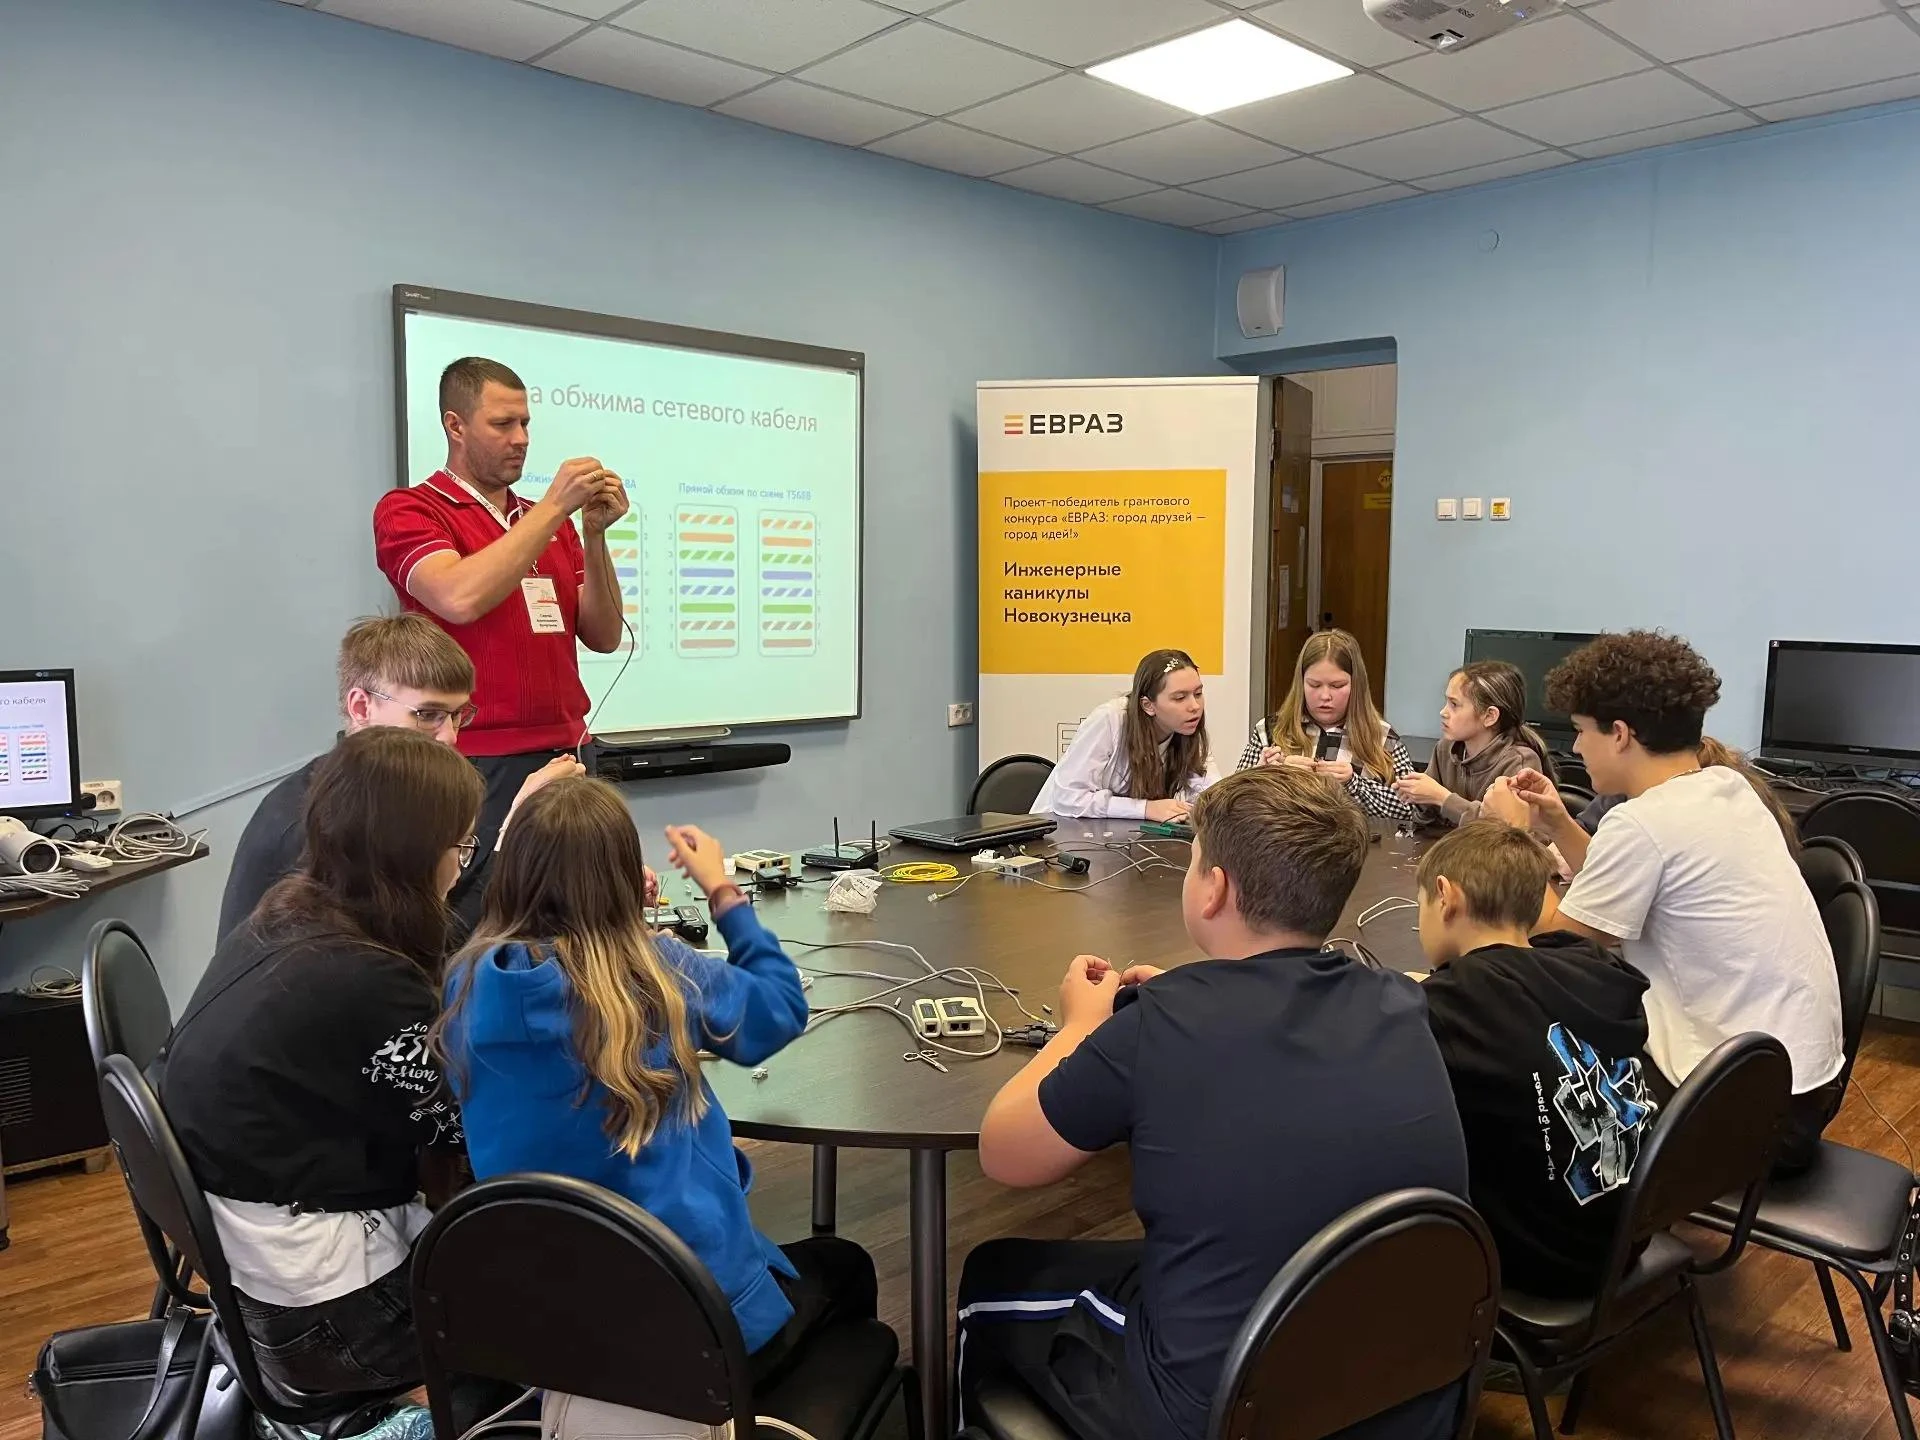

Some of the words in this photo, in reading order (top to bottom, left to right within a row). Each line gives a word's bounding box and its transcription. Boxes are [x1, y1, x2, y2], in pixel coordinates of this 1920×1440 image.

[551, 384, 645, 414] обжима
[652, 399, 745, 425] сетевого
[751, 407, 817, 432] кабеля
[1029, 413, 1123, 435] ЕВРАЗ
[679, 482, 714, 495] Прямой
[747, 489, 758, 497] по
[1004, 496, 1120, 509] Проект-победитель
[1123, 498, 1190, 508] грантового
[1004, 515, 1058, 525] конкурса
[1061, 511, 1109, 523] «ЕВРАЗ:
[1112, 514, 1147, 524] город
[1151, 512, 1192, 524] друзей
[1004, 531, 1037, 541] город
[1041, 528, 1080, 541] идей!»
[1004, 561, 1122, 580] Инженерные
[1004, 588, 1089, 603] каникулы
[1004, 607, 1132, 627] Новокузнецка
[12, 696, 46, 705] кабеля
